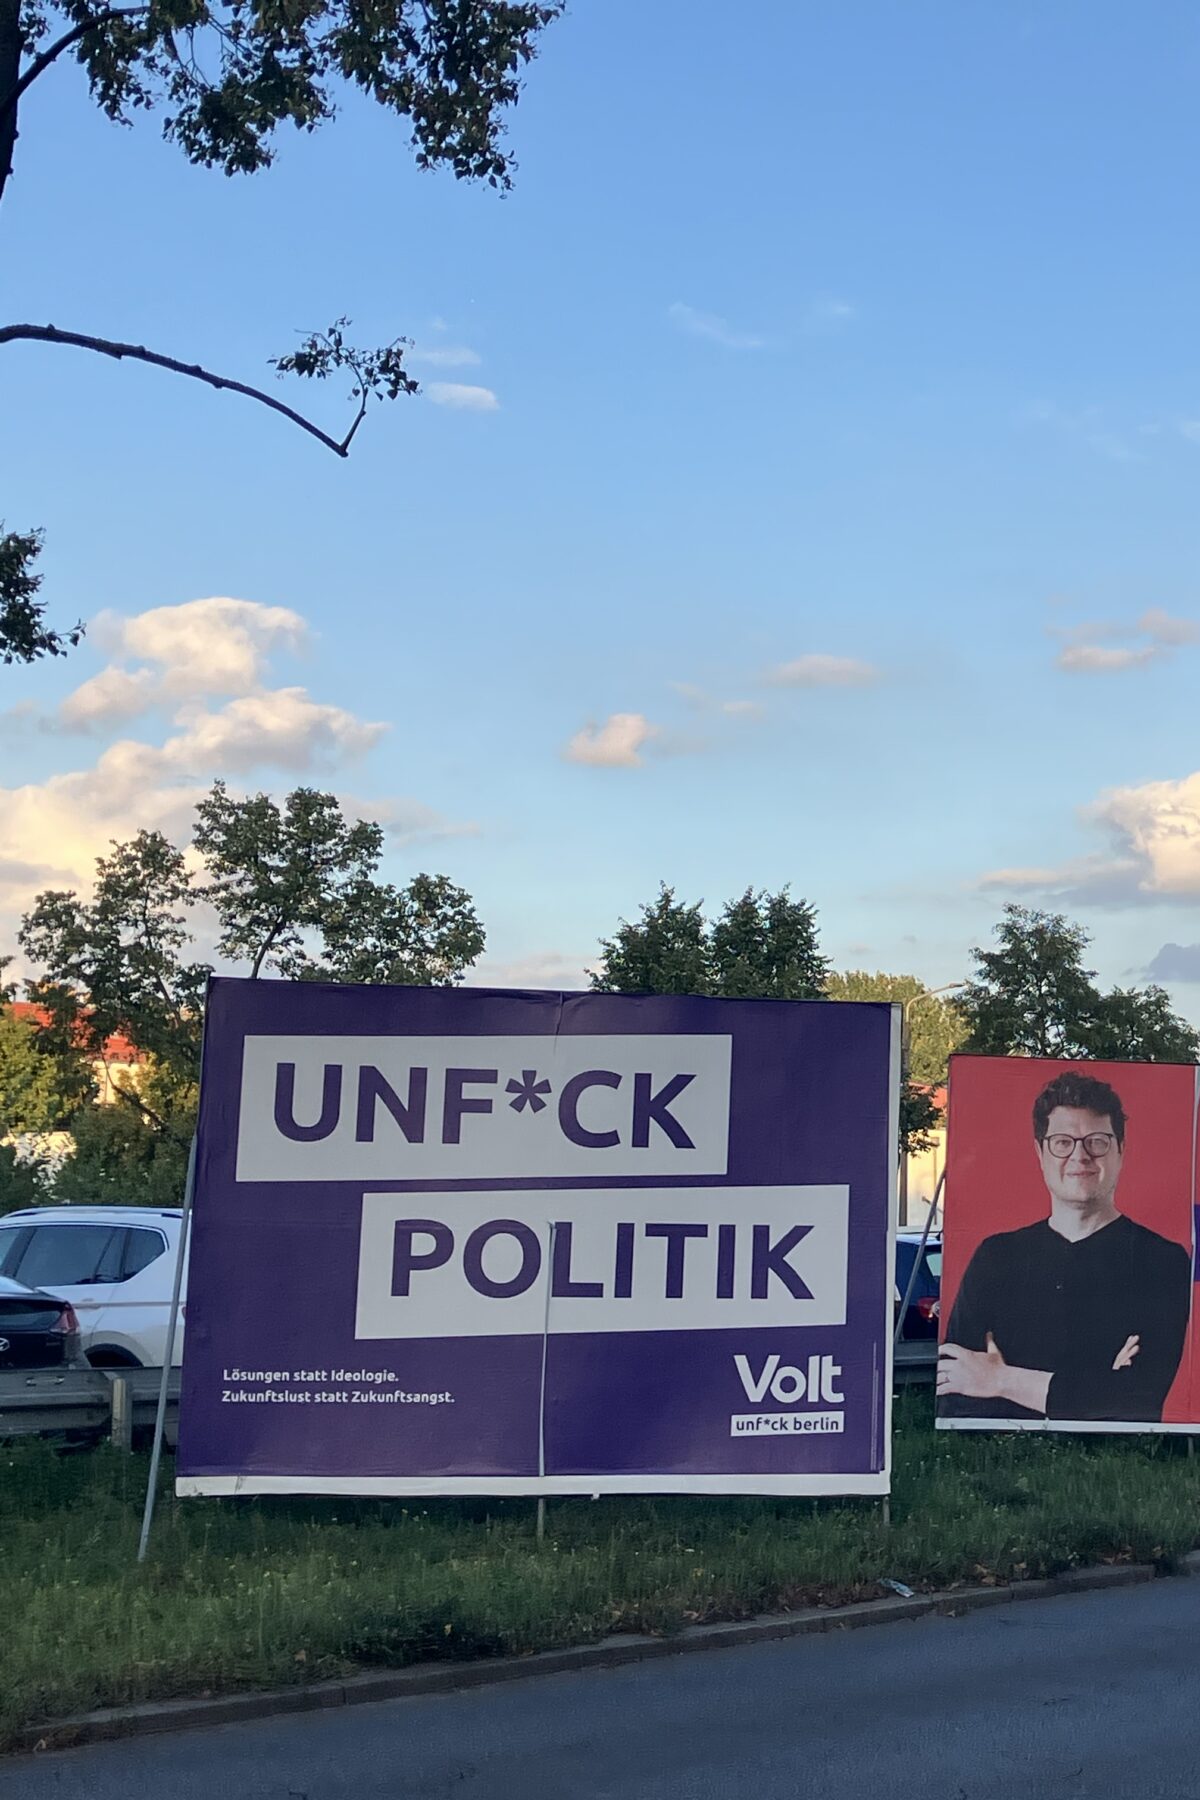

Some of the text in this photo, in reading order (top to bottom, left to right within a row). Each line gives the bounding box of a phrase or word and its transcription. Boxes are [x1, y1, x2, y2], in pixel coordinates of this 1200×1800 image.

[389, 1218, 816, 1300] POLITIK
[223, 1369, 399, 1384] Lösungen statt Ideologie.
[733, 1354, 845, 1404] Volt
[222, 1390, 455, 1405] Zukunftslust statt Zukunftsangst.
[793, 1416, 840, 1431] berlin
